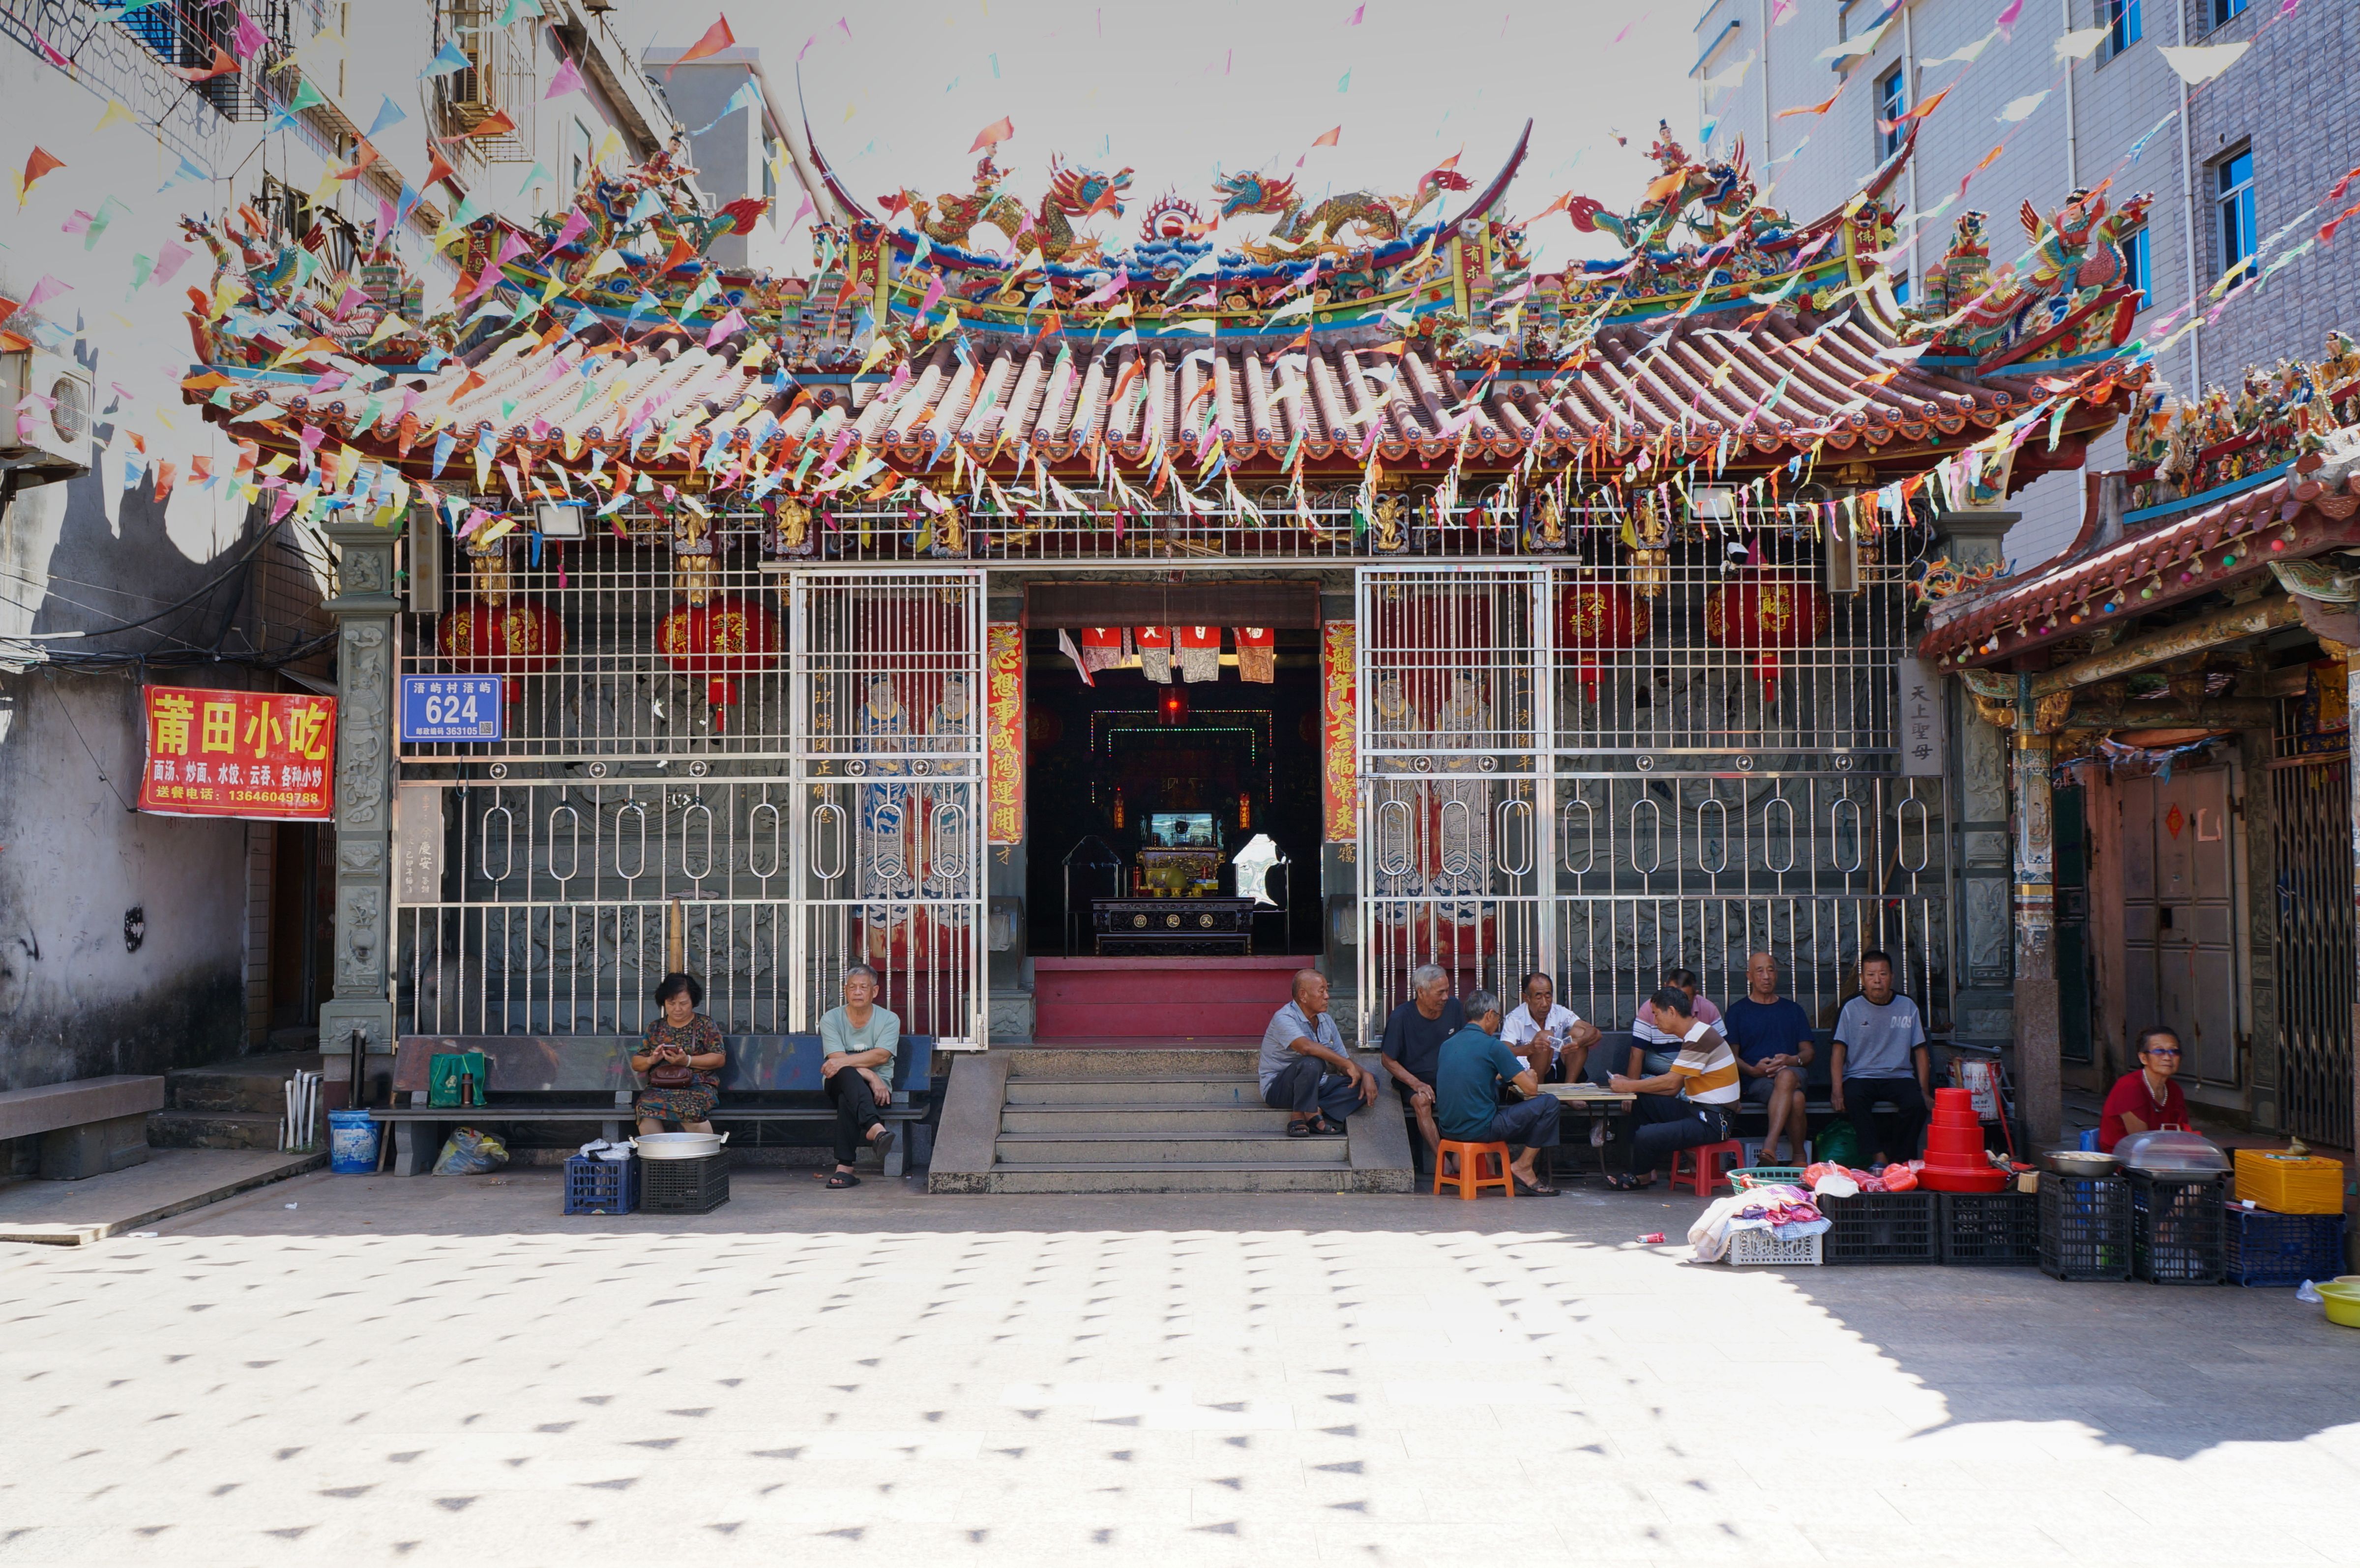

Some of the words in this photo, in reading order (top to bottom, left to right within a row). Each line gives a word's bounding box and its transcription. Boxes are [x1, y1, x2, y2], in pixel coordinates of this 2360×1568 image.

[858, 249, 877, 283] 必應
[1463, 245, 1481, 280] 有求
[413, 682, 491, 694] 浯屿村浯屿
[426, 695, 478, 724] 624
[1910, 686, 1933, 760] 天上聖母
[153, 694, 327, 760] 莆田小吃
[446, 727, 477, 735] 363105
[988, 649, 1018, 832] 心想事成鴻運開
[154, 759, 322, 788] 面汤、炒面、水饺、云吞、各种小炒
[229, 790, 318, 803] 13646049788
